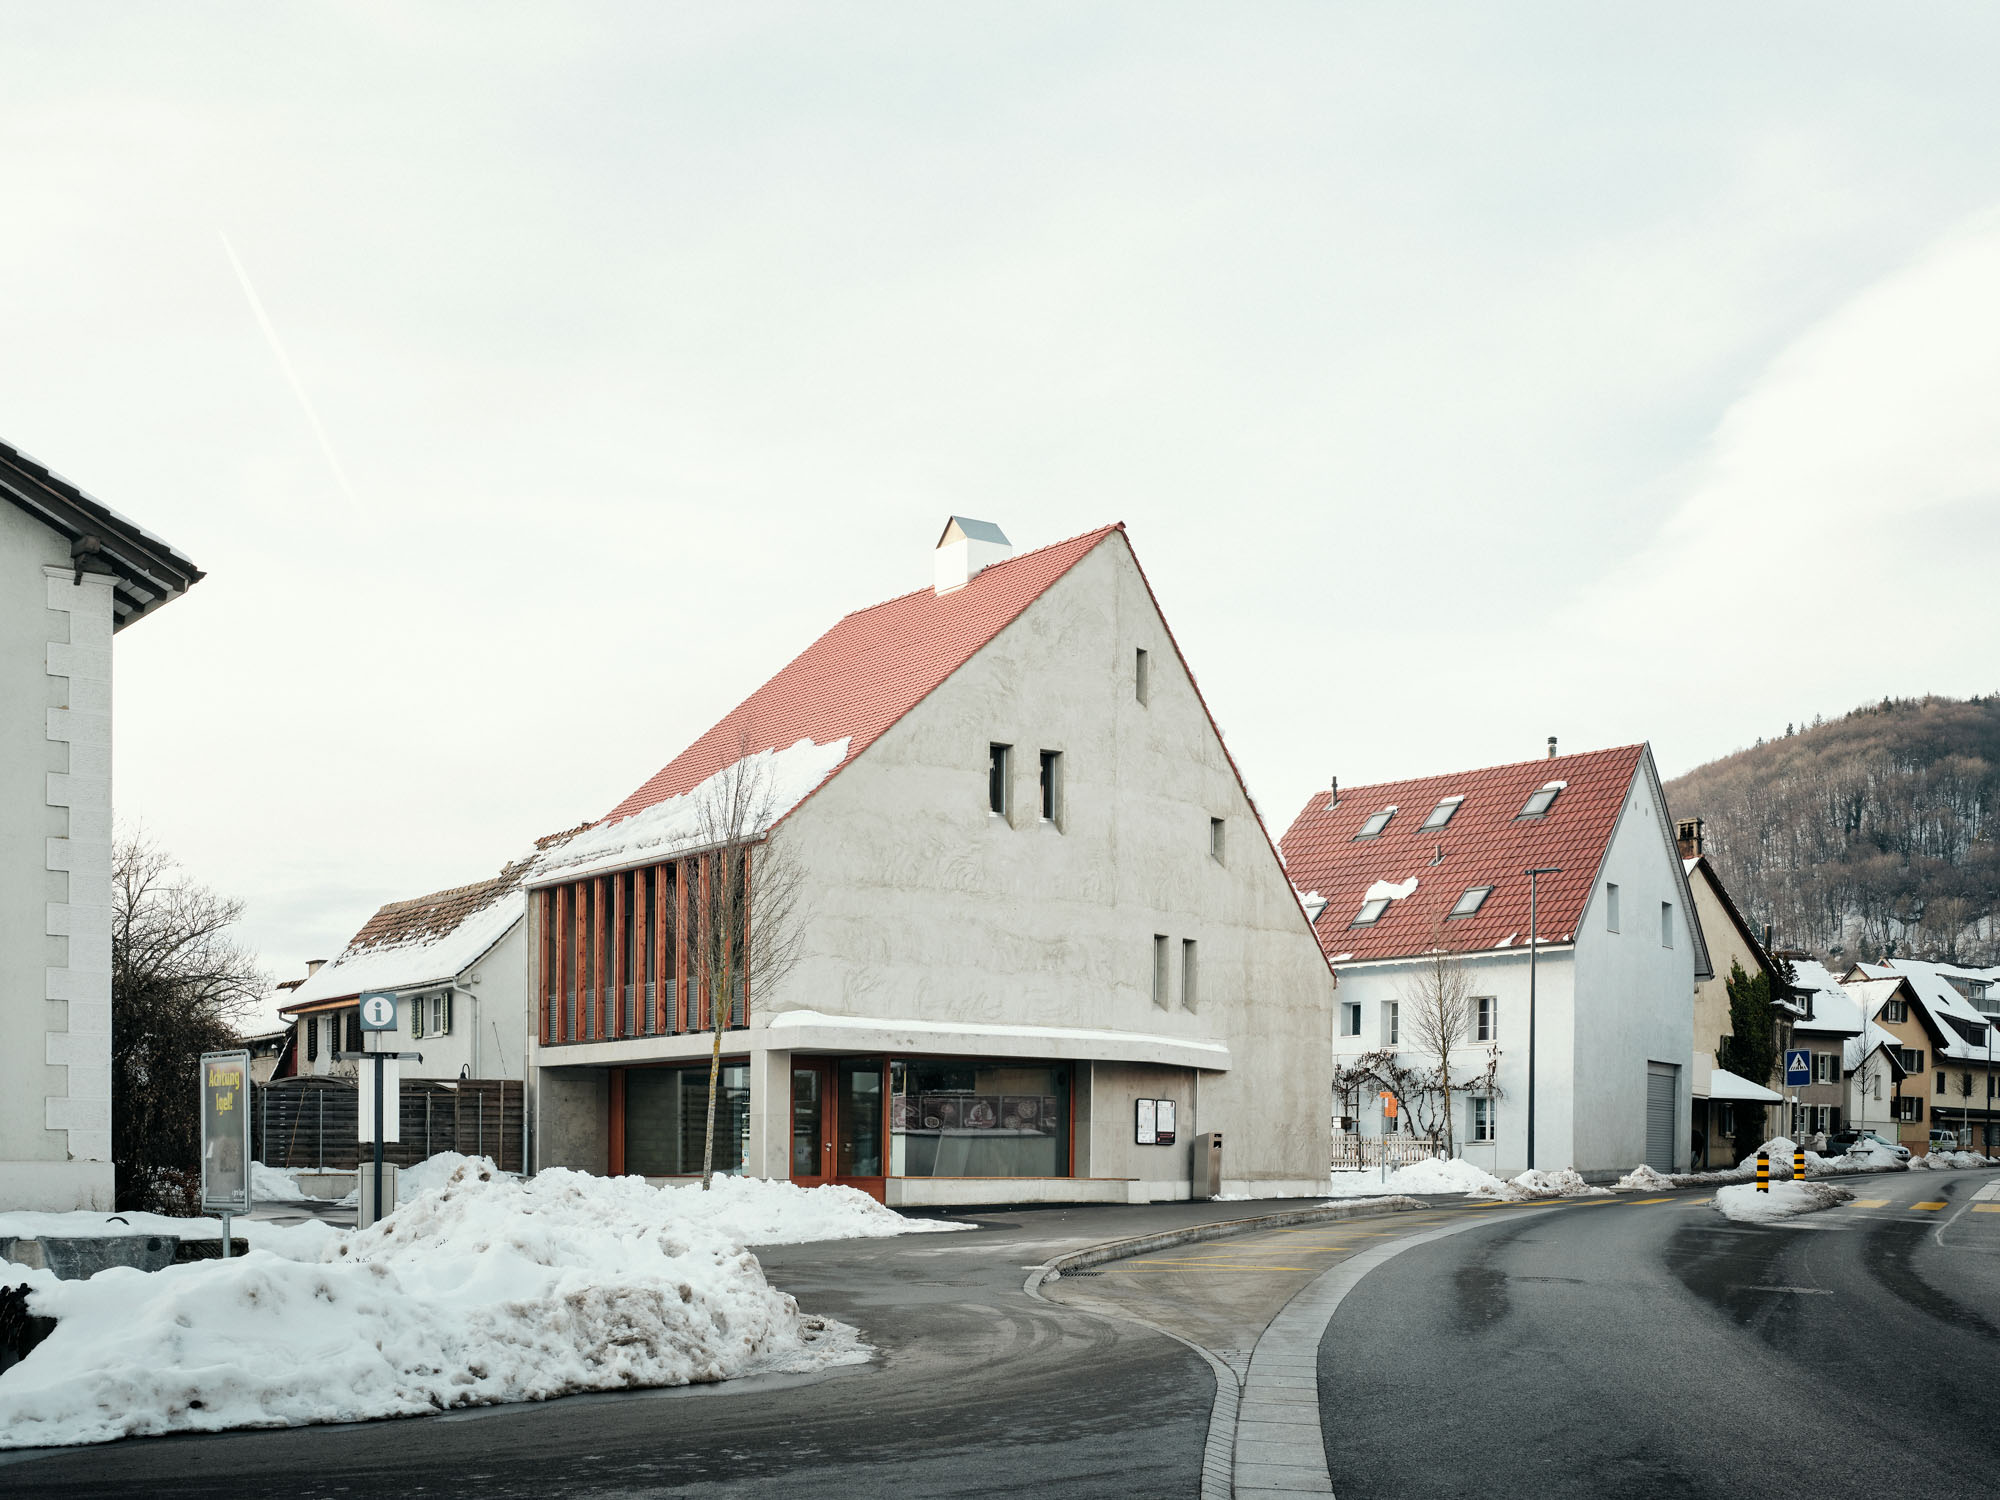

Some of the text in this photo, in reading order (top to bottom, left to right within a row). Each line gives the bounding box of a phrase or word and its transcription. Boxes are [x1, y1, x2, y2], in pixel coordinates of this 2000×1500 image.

[373, 1001, 384, 1022] i
[208, 1069, 240, 1091] Achtung
[215, 1092, 233, 1116] Igel!
